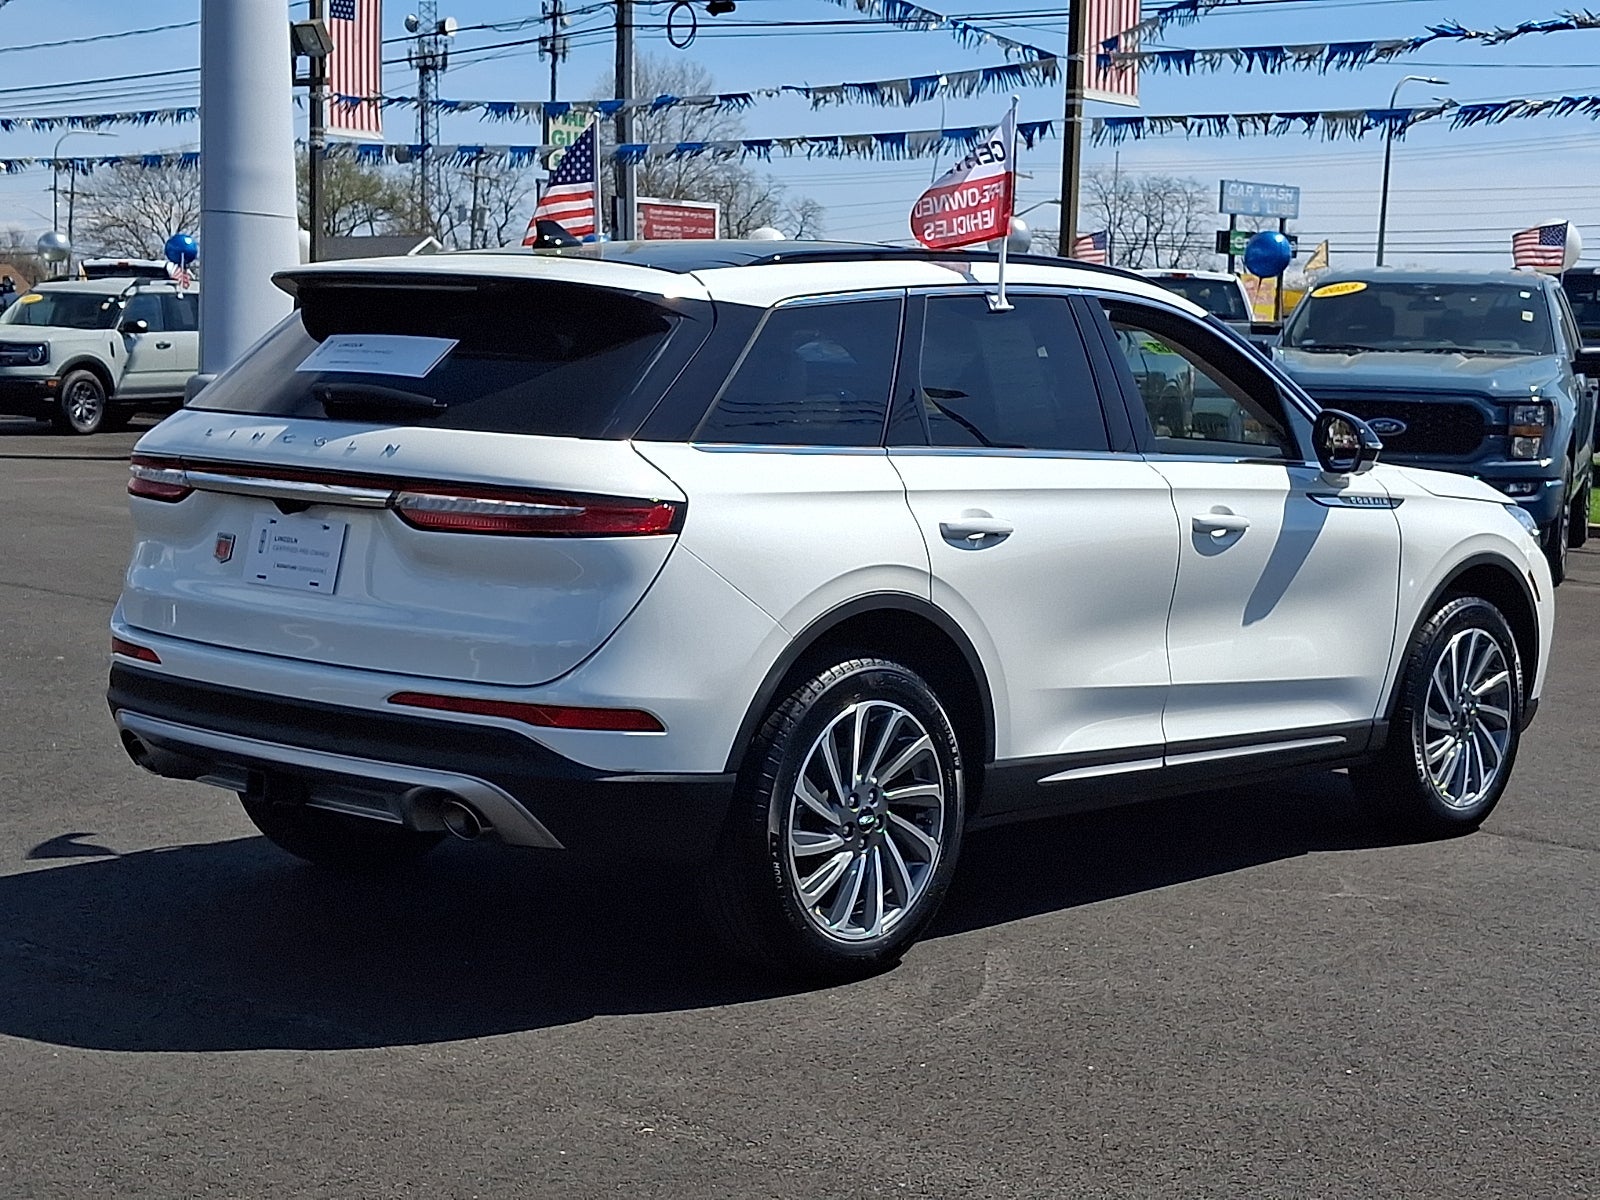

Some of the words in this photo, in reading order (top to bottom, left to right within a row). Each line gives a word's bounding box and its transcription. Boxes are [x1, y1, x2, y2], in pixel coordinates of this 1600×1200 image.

[1228, 183, 1254, 197] CAR
[1260, 187, 1294, 202] WASH
[205, 428, 401, 457] LINCOLN
